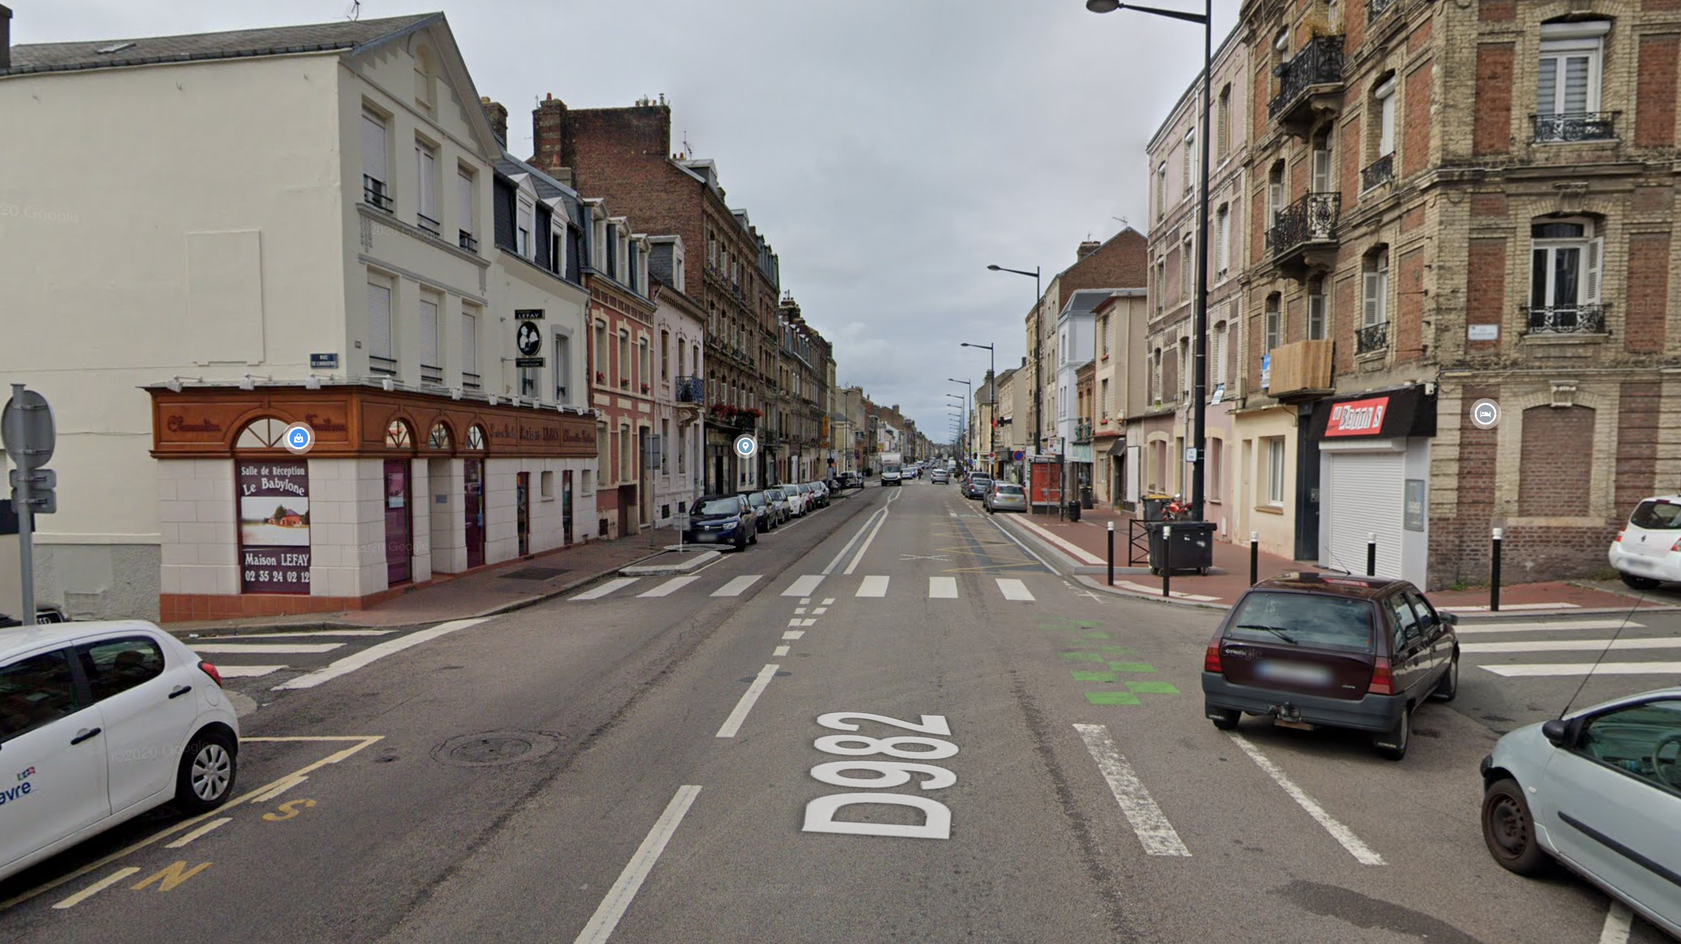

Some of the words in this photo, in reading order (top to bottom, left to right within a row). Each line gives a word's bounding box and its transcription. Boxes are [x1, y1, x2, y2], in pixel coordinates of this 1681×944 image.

[241, 466, 258, 476] Salle
[260, 466, 270, 476] de
[272, 466, 306, 478] Réception
[242, 483, 257, 496] Le
[261, 477, 306, 497] Babylone
[245, 553, 277, 566] Maison
[281, 553, 309, 567] LEFAY
[245, 570, 256, 582] 02
[259, 571, 270, 582] 35
[272, 571, 284, 583] 24
[286, 571, 298, 583] 02
[301, 571, 310, 583] 12
[802, 712, 959, 840] D982
